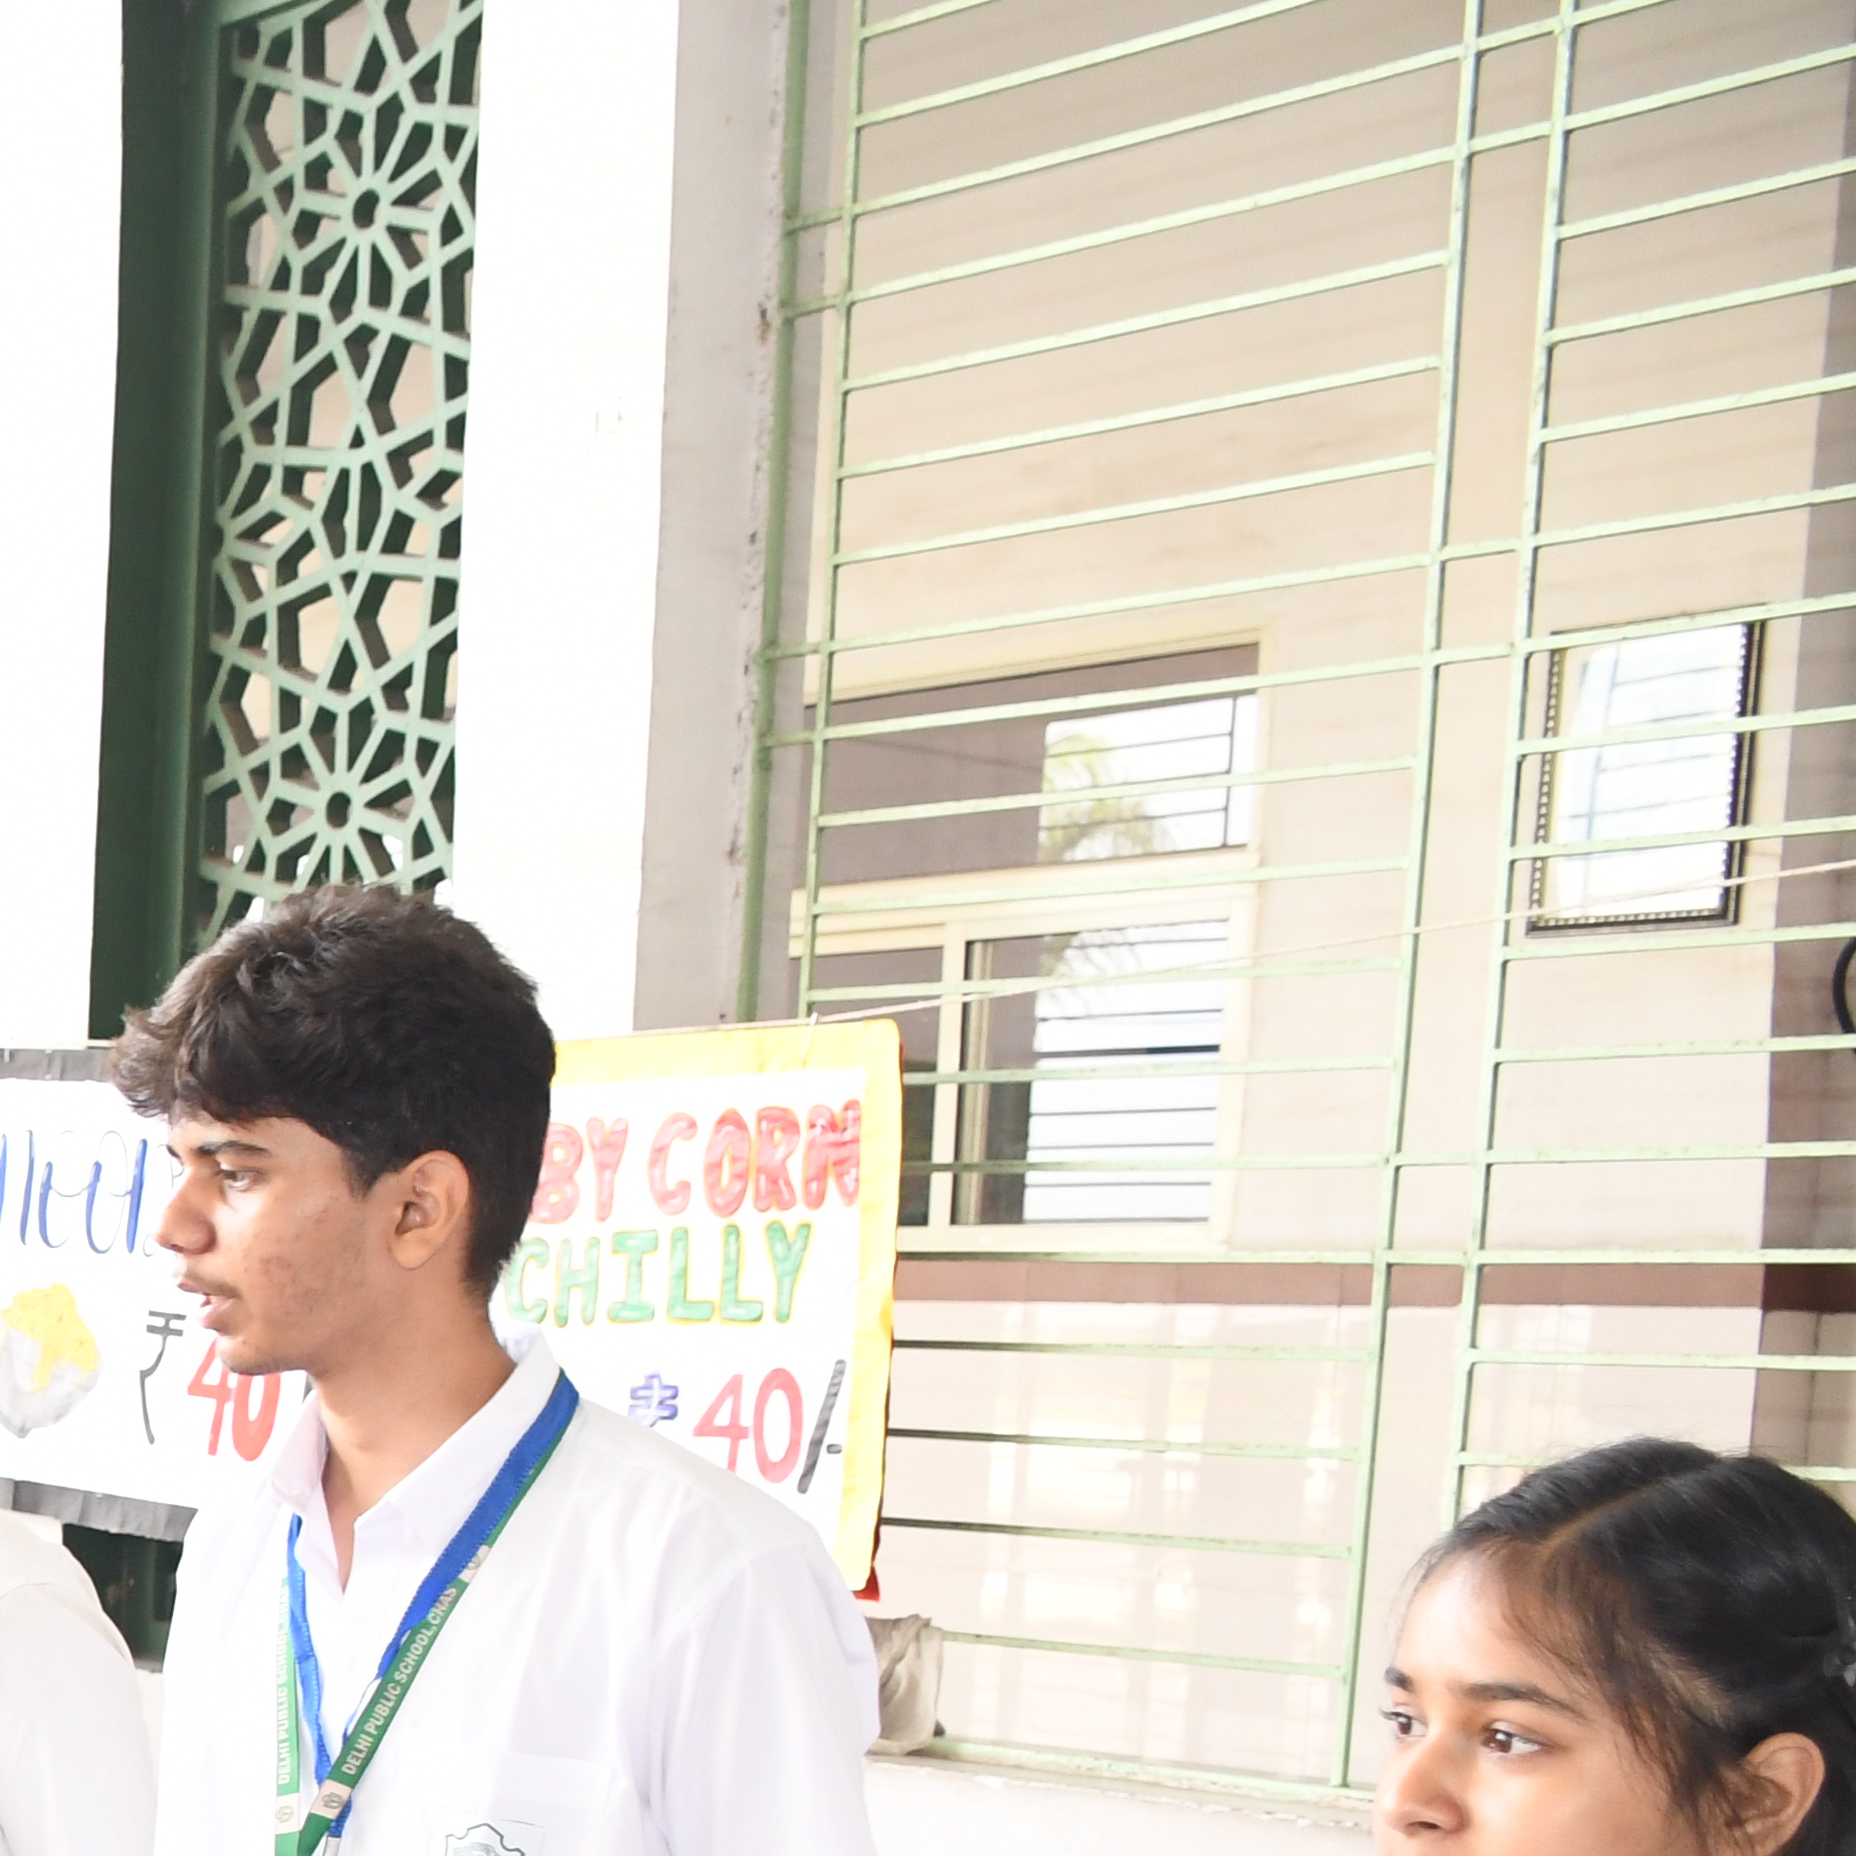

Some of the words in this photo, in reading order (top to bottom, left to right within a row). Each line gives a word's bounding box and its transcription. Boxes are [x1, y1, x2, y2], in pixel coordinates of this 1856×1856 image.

[648, 1098, 862, 1217] CORN
[505, 1219, 813, 1326] CHILLY
[277, 1687, 290, 1738] PUBLIC
[341, 1729, 375, 1775] DELHI
[364, 1682, 402, 1736] PUBLIC
[277, 1742, 291, 1785] DELHI
